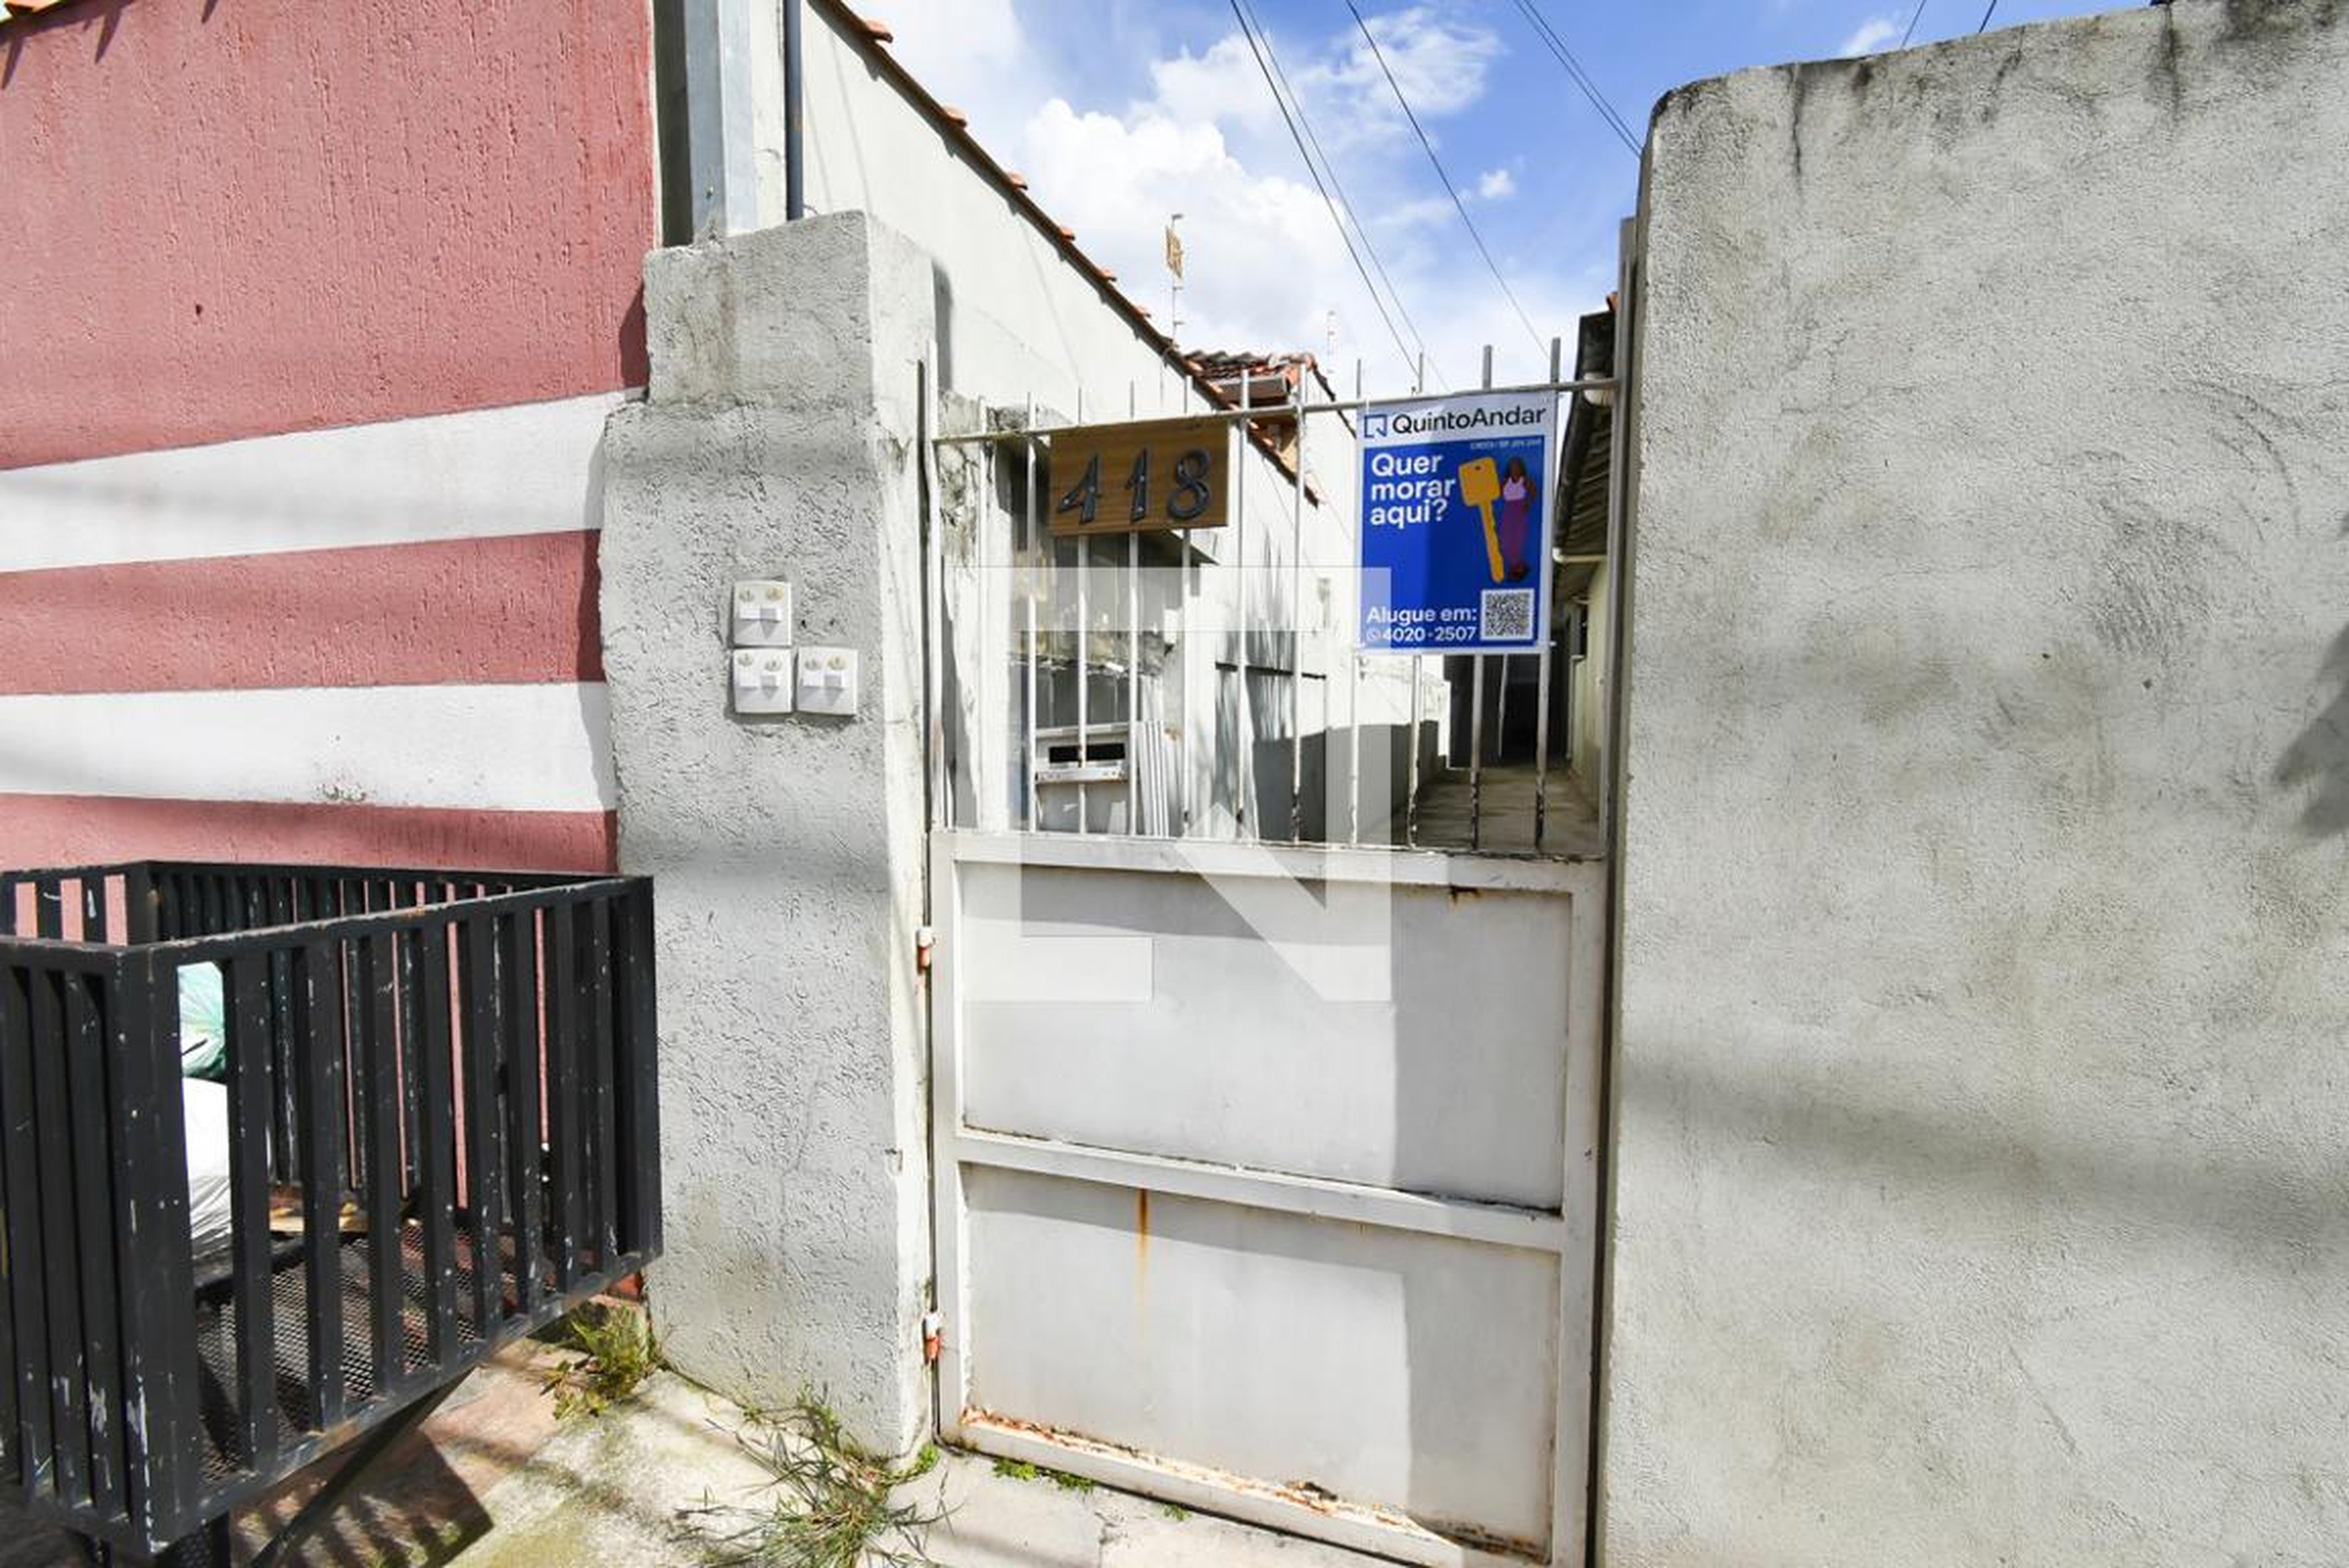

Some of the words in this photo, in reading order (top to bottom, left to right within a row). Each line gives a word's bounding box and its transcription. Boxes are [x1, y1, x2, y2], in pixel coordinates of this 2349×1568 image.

[1392, 406, 1546, 434] QuintoAndar
[1371, 453, 1443, 476] Quer
[1057, 449, 1211, 524] 418
[1371, 479, 1455, 500] morar
[1370, 498, 1448, 529] aqui?
[1366, 607, 1436, 627] Alugue
[1441, 608, 1477, 622] em:
